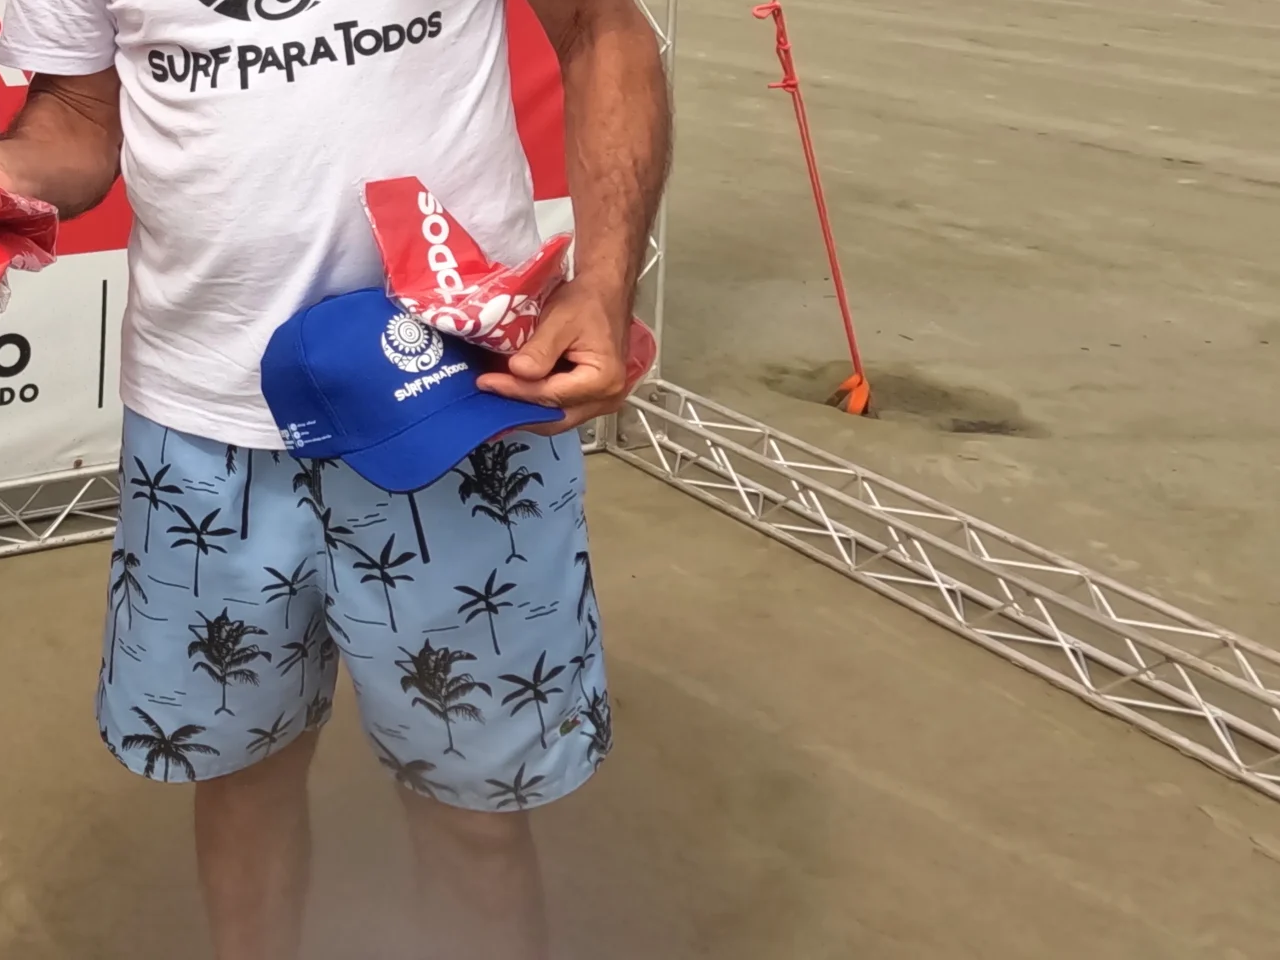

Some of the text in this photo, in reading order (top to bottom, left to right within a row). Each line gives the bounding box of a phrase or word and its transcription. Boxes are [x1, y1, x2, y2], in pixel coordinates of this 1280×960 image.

[148, 11, 443, 92] SURF PARA TODOS
[394, 362, 469, 402] SURF PARA TODOS
